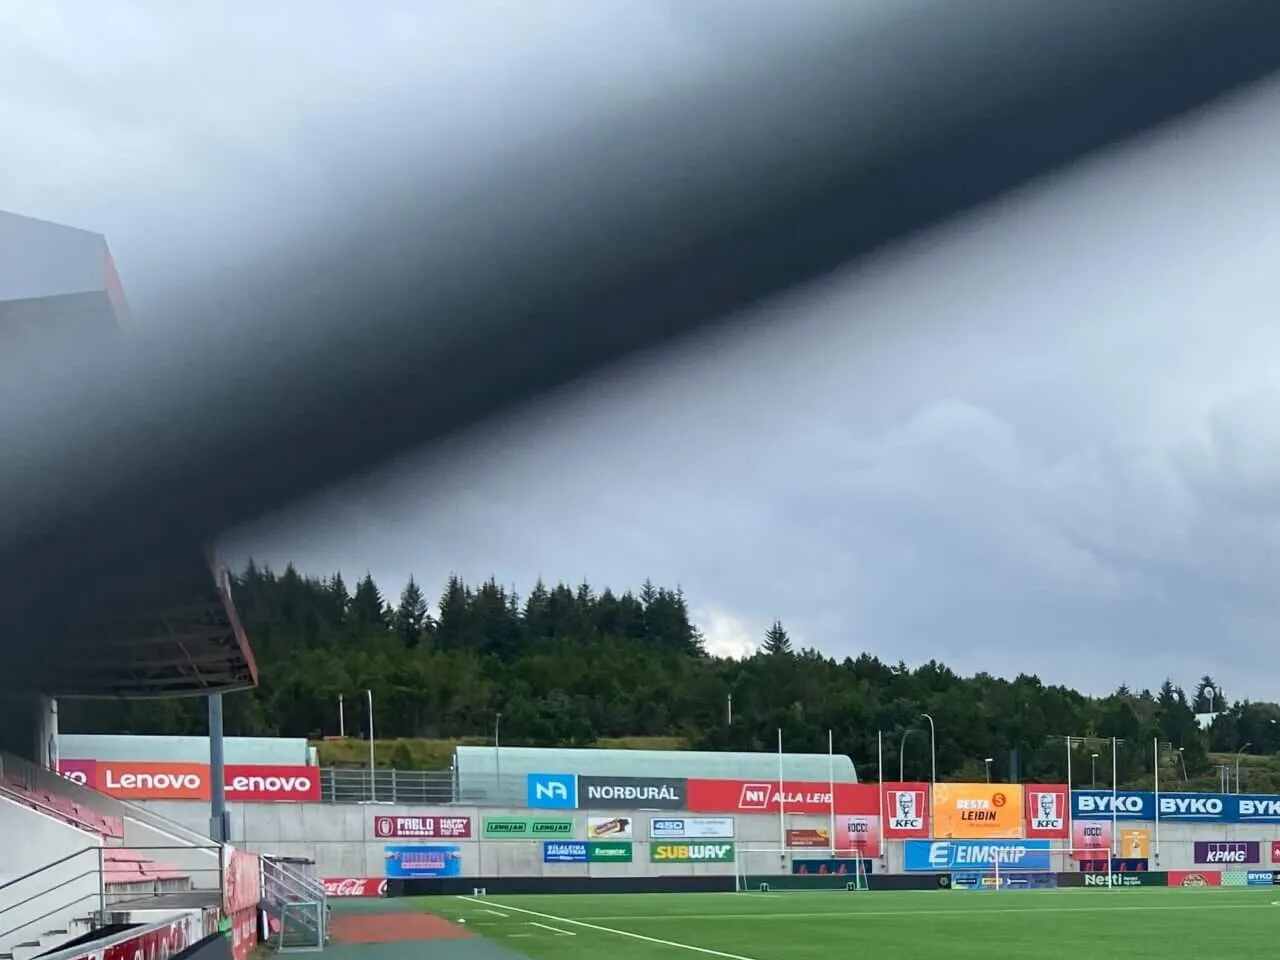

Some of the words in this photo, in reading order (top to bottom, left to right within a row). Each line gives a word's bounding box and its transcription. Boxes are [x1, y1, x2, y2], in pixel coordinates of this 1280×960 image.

[106, 769, 201, 789] Lenovo
[588, 785, 679, 800] NORÐURÁL
[771, 792, 804, 803] ALLA
[1078, 796, 1143, 811] BYKO
[1160, 798, 1222, 814] BYKO
[397, 818, 434, 830] PABLO
[654, 845, 731, 859] SUBWAY
[956, 845, 1026, 863] EIMSKIP
[1206, 850, 1246, 862] KPMG
[1085, 873, 1122, 886] Nesti
[1248, 873, 1273, 881] BYKO
